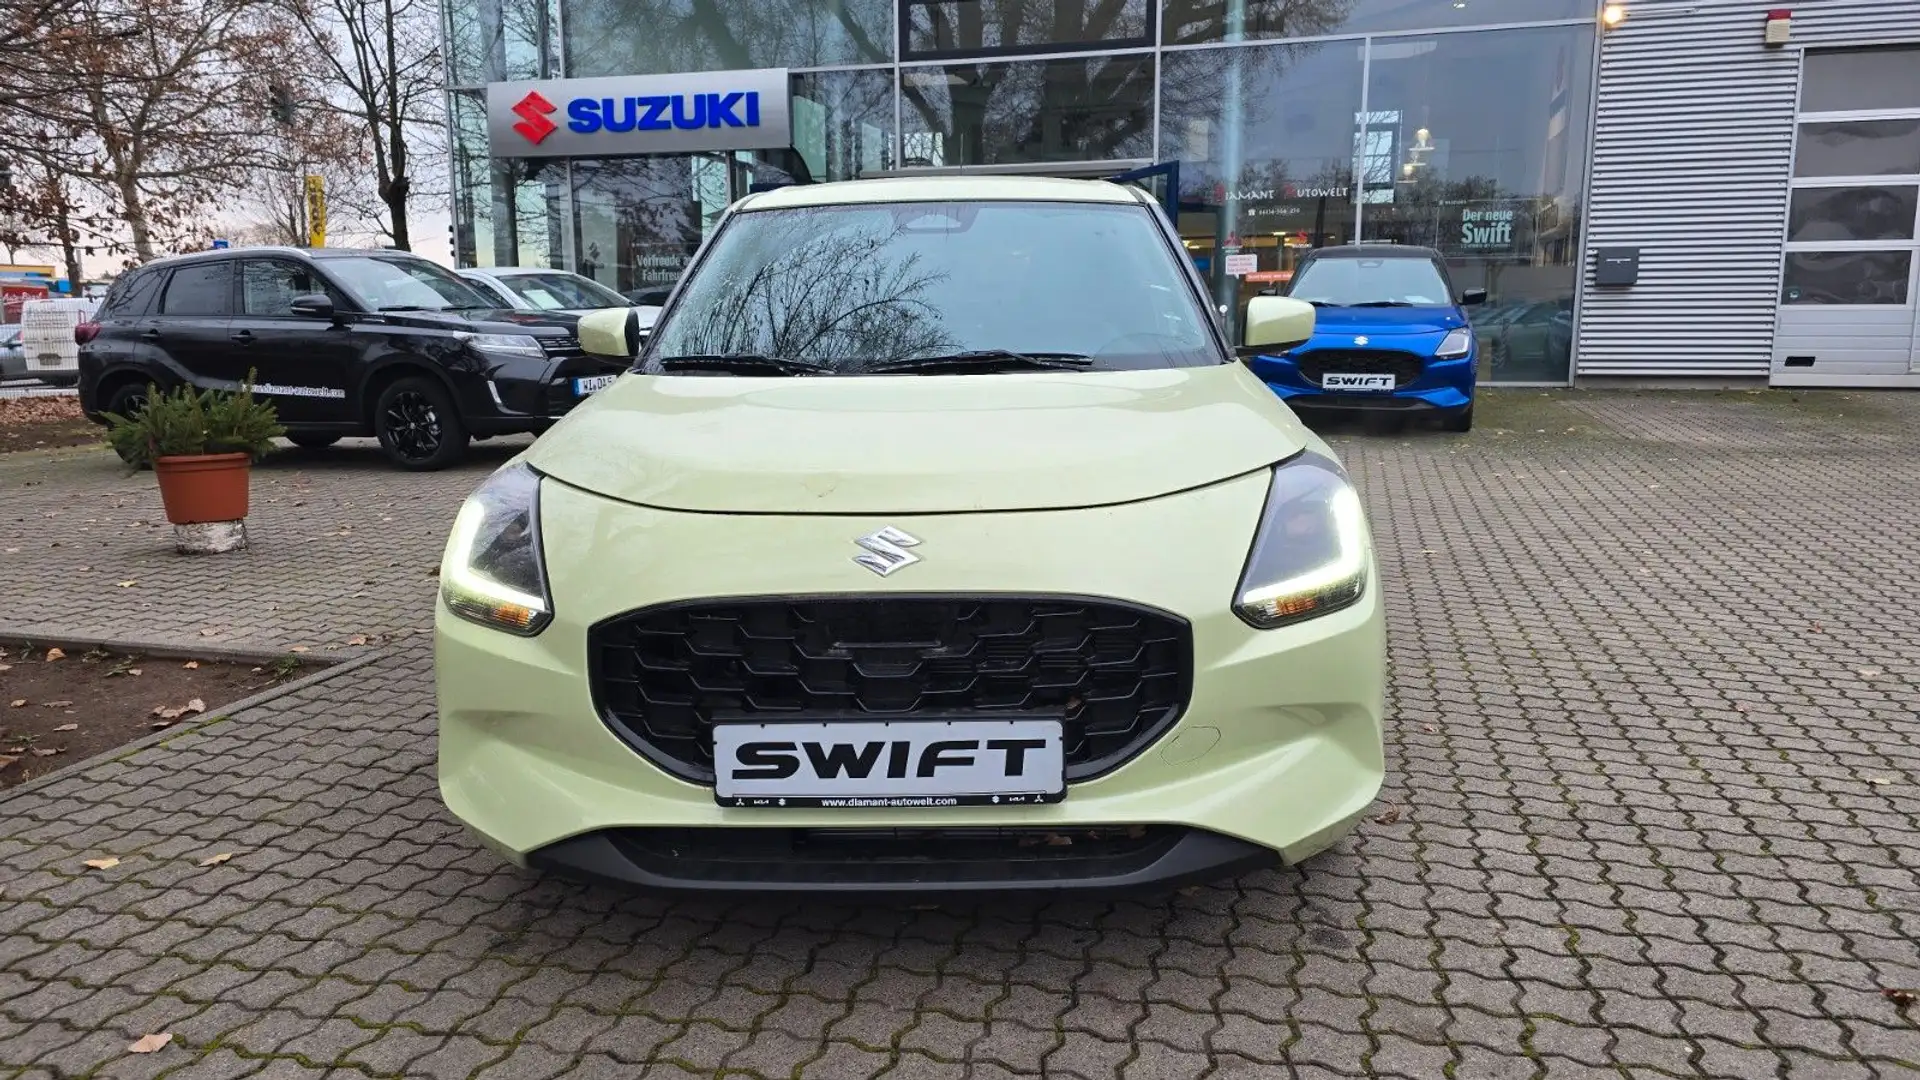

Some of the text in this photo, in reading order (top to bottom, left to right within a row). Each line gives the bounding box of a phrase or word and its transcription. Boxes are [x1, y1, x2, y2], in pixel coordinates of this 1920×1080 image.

[567, 91, 760, 134] SUZUKI
[1462, 208, 1513, 221] Der neue
[1461, 221, 1512, 244] Swift
[1326, 376, 1391, 386] SWIFT
[731, 739, 1047, 780] SWIFT
[821, 796, 957, 808] www.diamant-autowelt.com
